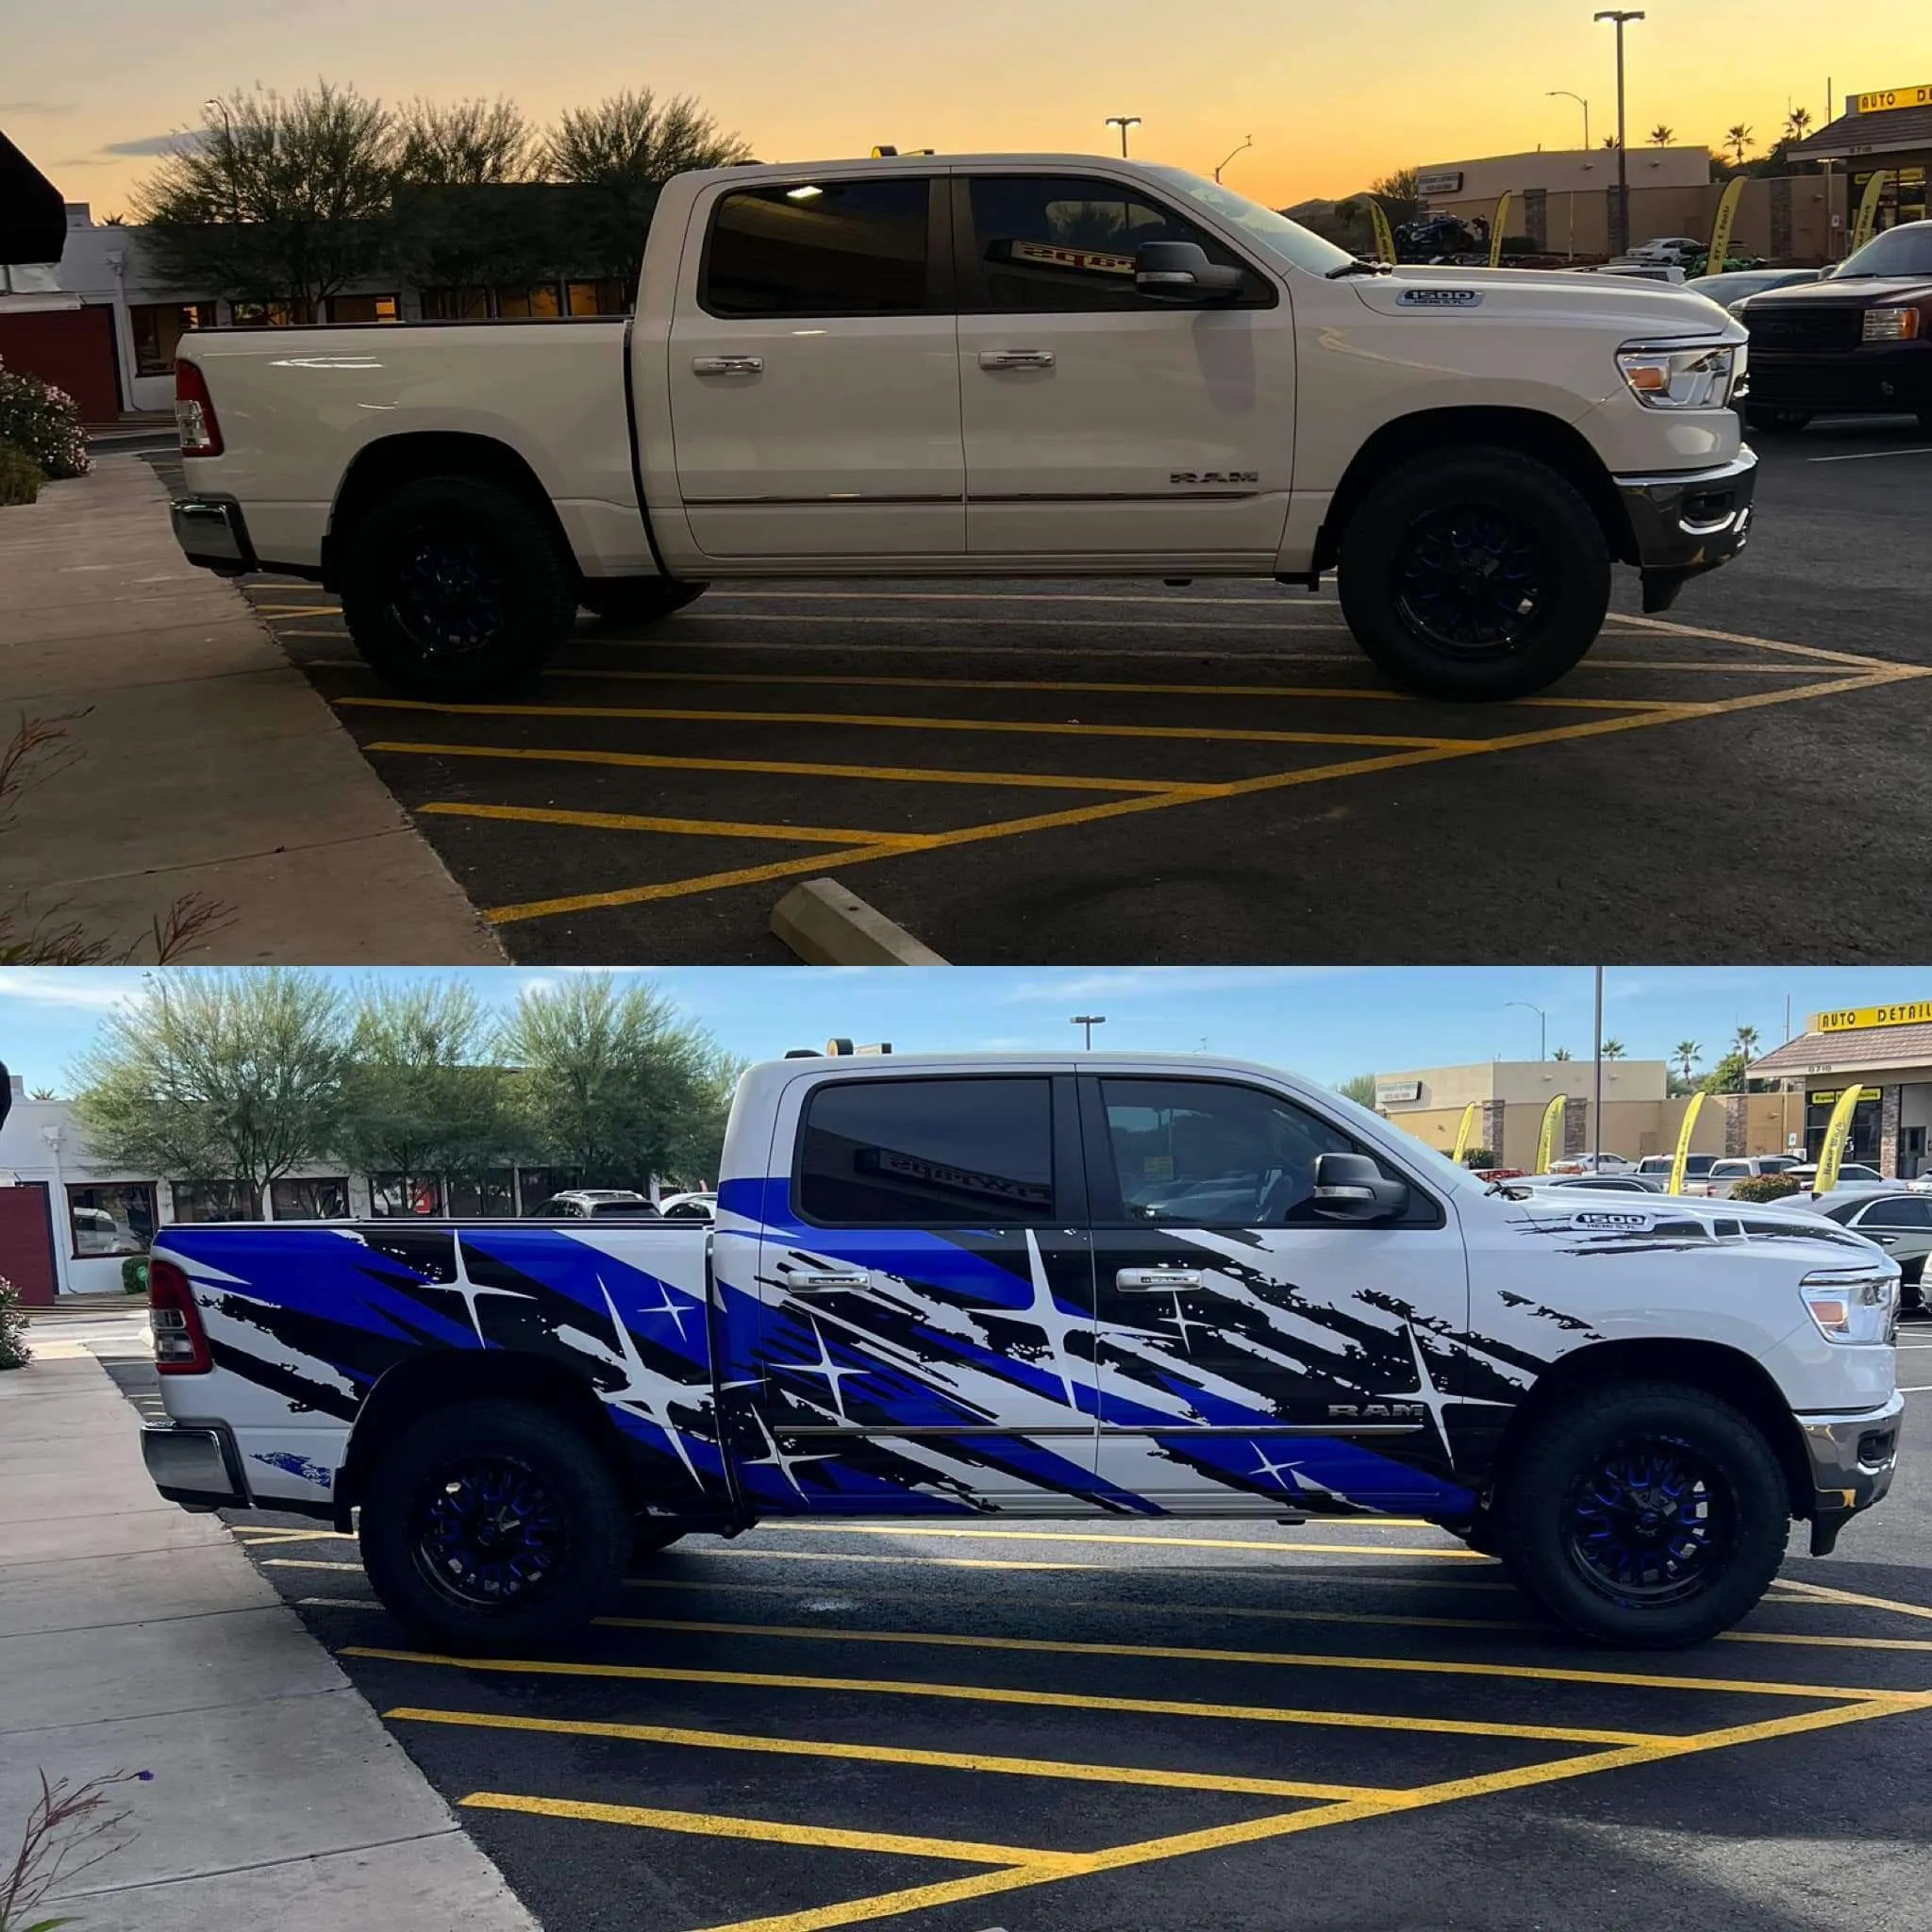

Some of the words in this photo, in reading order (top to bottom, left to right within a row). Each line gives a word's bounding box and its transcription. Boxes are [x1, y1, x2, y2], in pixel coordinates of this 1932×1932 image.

[1862, 92, 1895, 108] AUTO
[1412, 291, 1472, 300] 1500
[1169, 472, 1259, 484] RAM
[1823, 1011, 1857, 1027] AUTO
[1582, 1213, 1644, 1224] 1500
[1327, 1404, 1425, 1417] RAM
